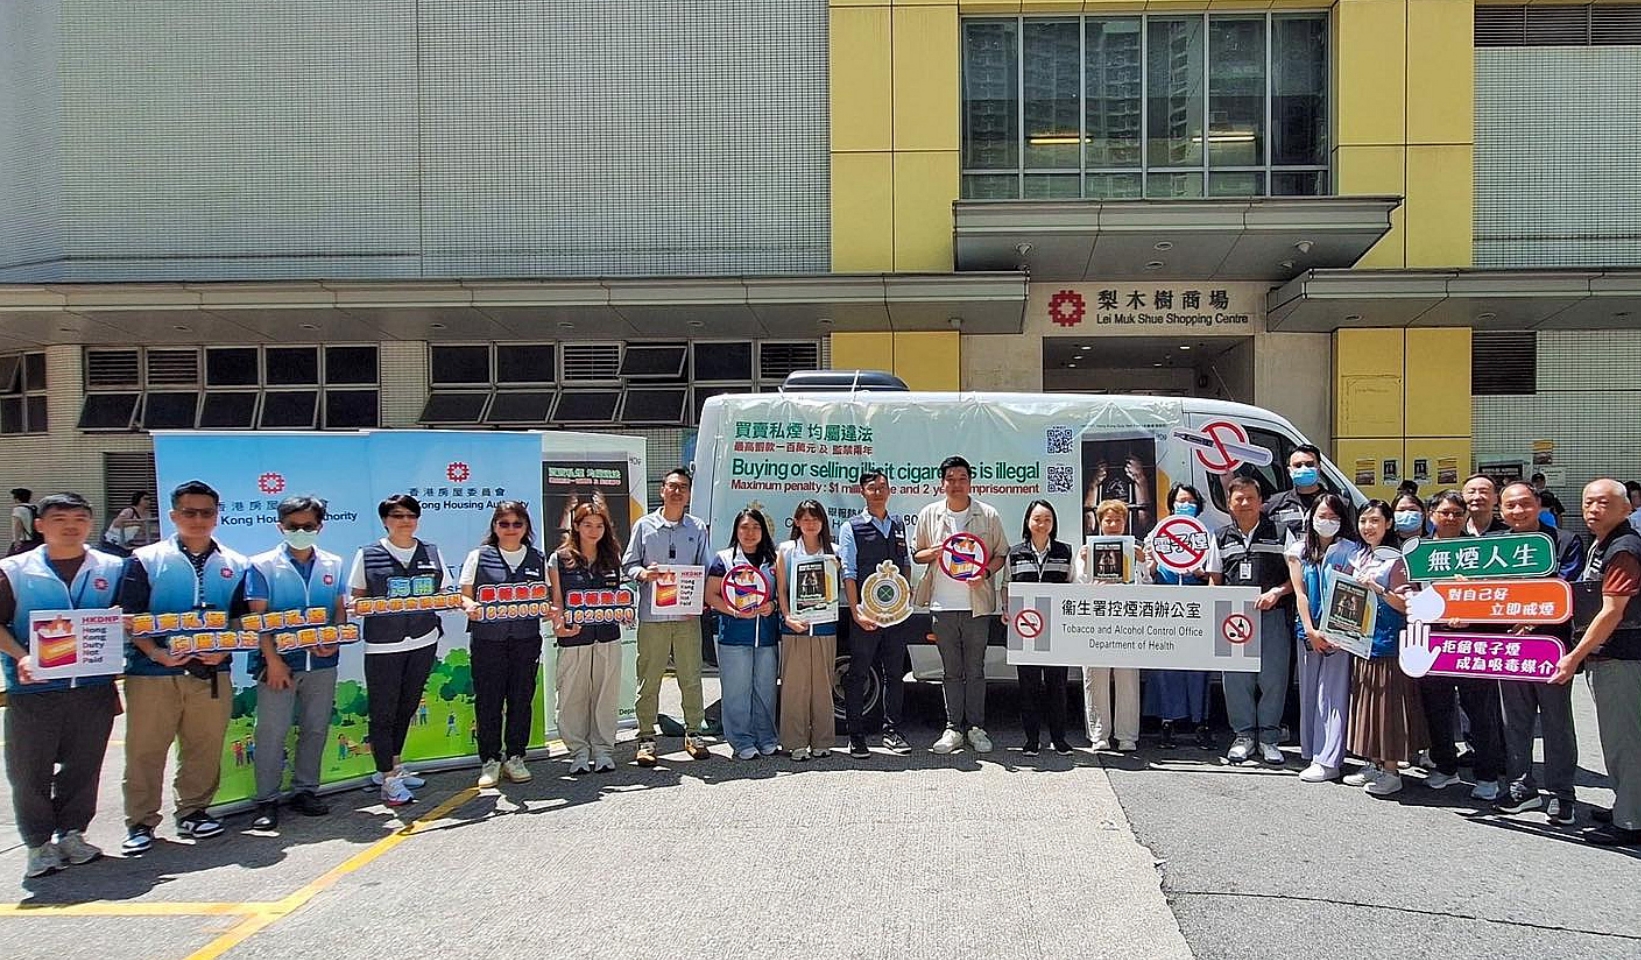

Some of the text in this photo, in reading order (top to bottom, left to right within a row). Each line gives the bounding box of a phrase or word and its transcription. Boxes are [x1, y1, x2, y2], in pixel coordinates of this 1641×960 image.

[1098, 289, 1229, 310] 梨木樹商場
[1096, 312, 1249, 326] Lei Muk Shue Shopping Centre
[735, 421, 873, 442] 買賣私煙 均屬違法
[819, 443, 828, 454] 及
[732, 458, 789, 480] Buying
[791, 462, 808, 477] or
[809, 461, 860, 483] selling
[980, 461, 994, 479] is
[995, 461, 1039, 483] illegal
[410, 487, 505, 496] 香港房屋委員會
[731, 479, 781, 490] Maximum
[784, 481, 822, 493] penalty
[829, 482, 839, 493] $1
[900, 484, 920, 494] and
[923, 483, 930, 494] 2
[969, 483, 1040, 495] mprisonment
[418, 501, 440, 510] ong
[443, 500, 484, 510] Housing
[220, 515, 253, 526] Kong
[1427, 543, 1538, 572] 無煙人生
[1448, 588, 1508, 601] 對自己好
[1490, 602, 1555, 616] 立即戒煙
[1062, 623, 1204, 637] Tobacco and Alcohol Control Office
[1088, 638, 1176, 650] Department of Health
[1442, 640, 1522, 656] 拒絕電子煙
[1455, 656, 1554, 675] 成為吸毒媒介
